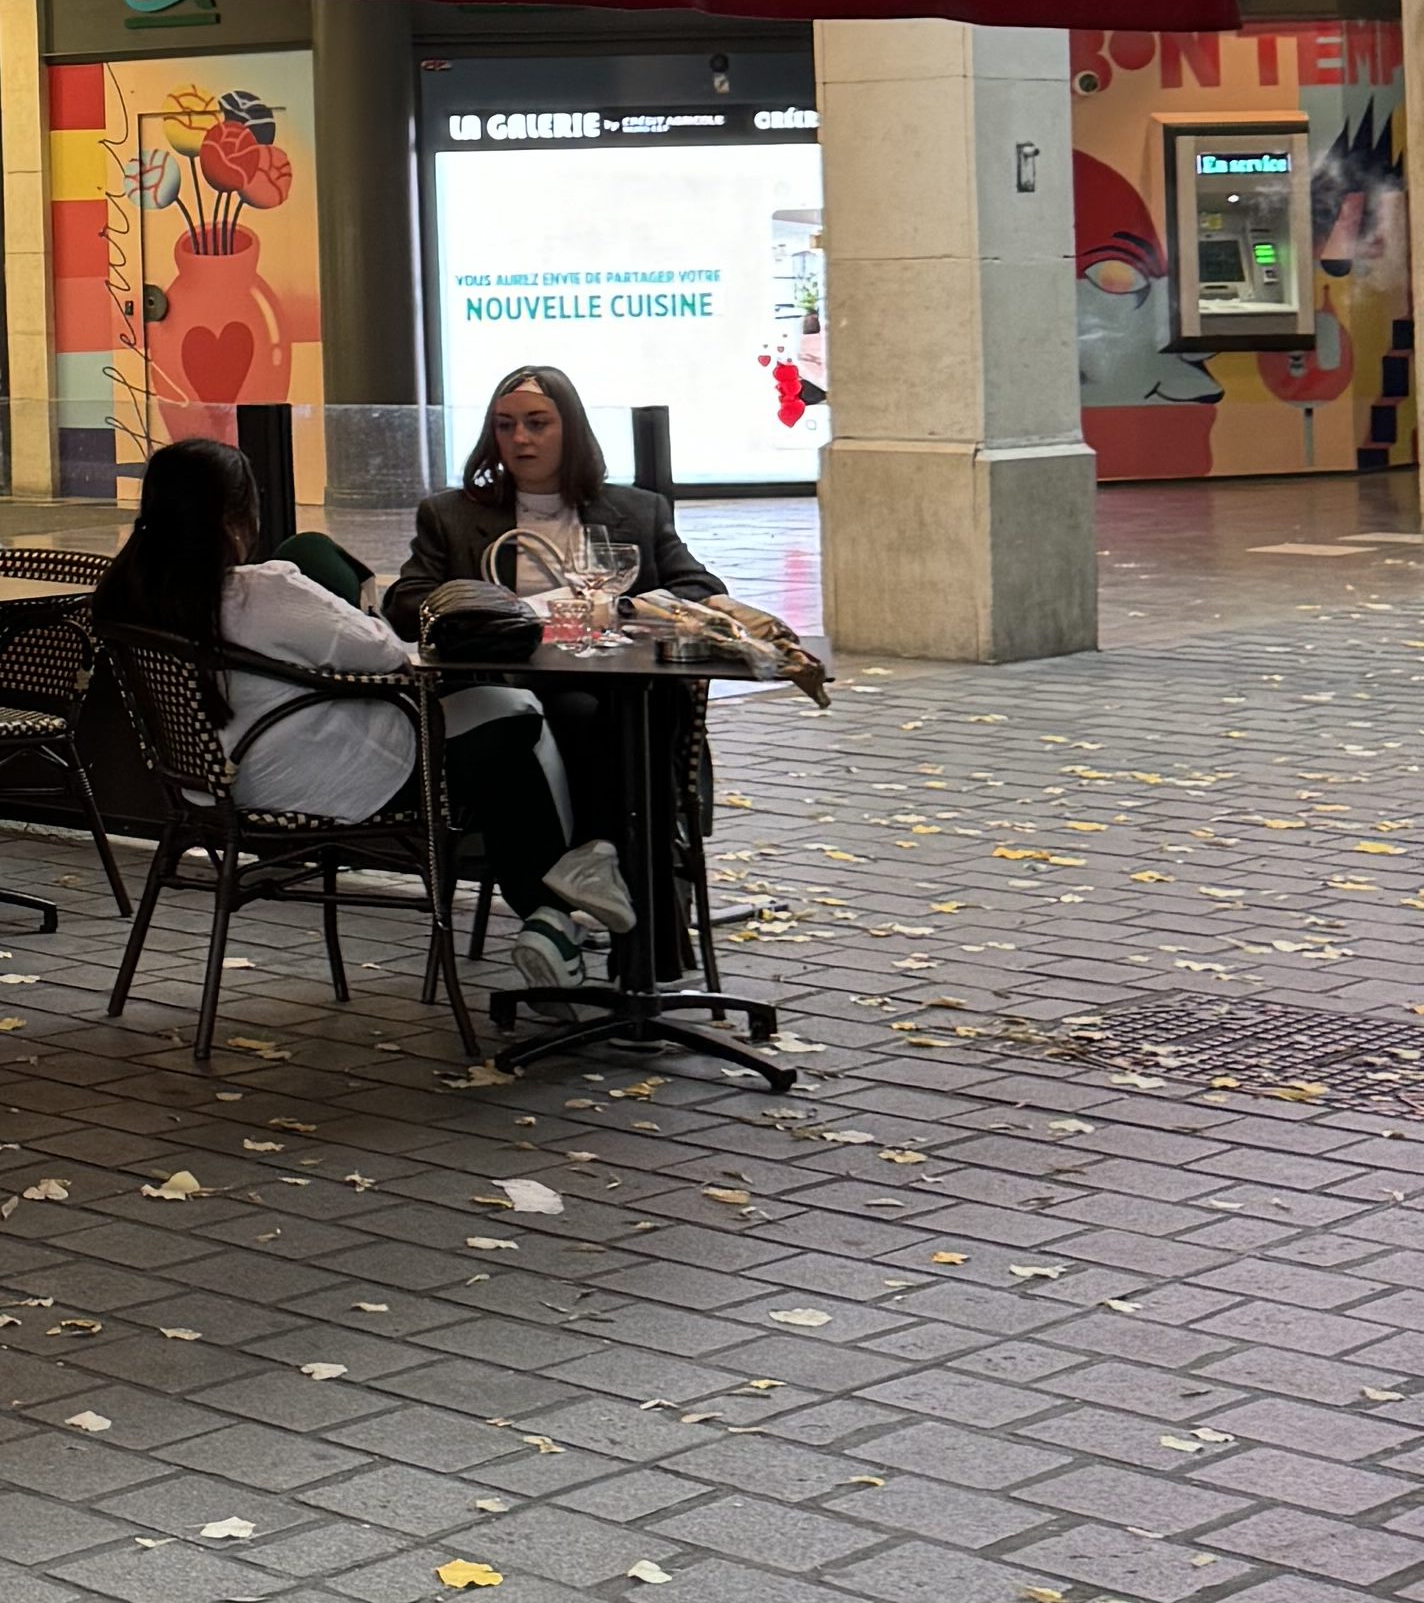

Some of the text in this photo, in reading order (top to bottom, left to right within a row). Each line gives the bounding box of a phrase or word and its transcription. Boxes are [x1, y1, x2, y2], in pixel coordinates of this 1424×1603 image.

[449, 114, 481, 141] LA
[487, 112, 601, 140] GALERIE
[1202, 155, 1228, 173] En
[456, 269, 721, 287] VOUS AUREZ ENVIE DE PARTAGER VOTRE
[466, 292, 714, 321] NOUVELLE CUISINE
